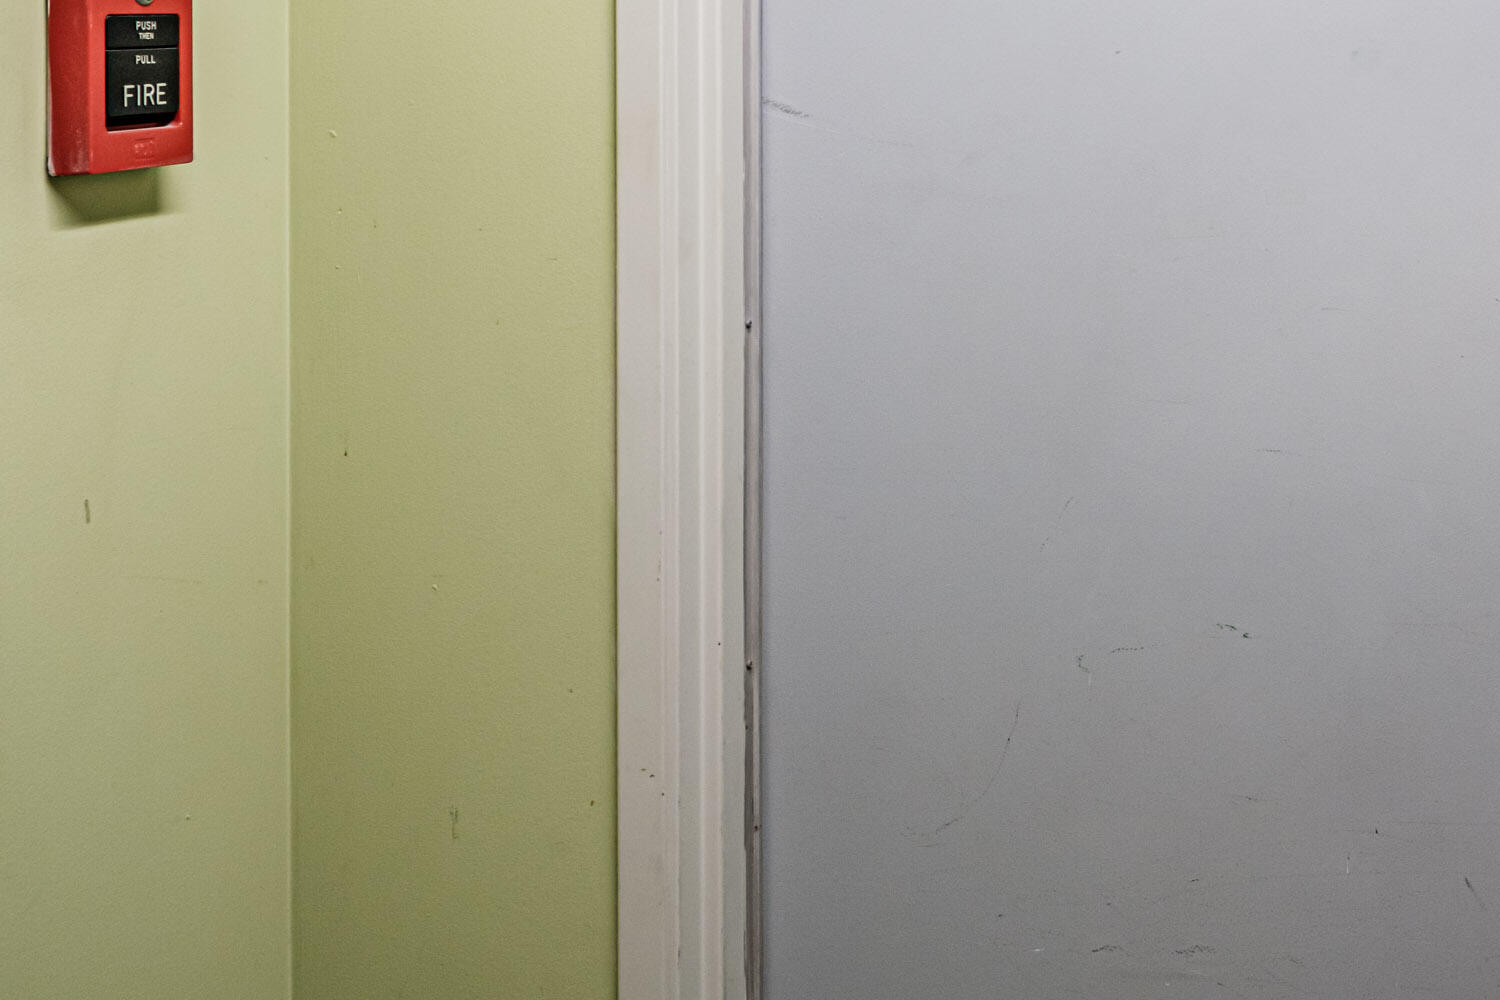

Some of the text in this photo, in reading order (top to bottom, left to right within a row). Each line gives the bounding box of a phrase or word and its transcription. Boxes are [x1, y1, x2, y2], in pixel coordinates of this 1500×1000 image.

[135, 20, 157, 31] PUSH
[138, 32, 155, 40] THEN
[135, 54, 156, 65] PULL
[123, 82, 168, 108] FIRE
